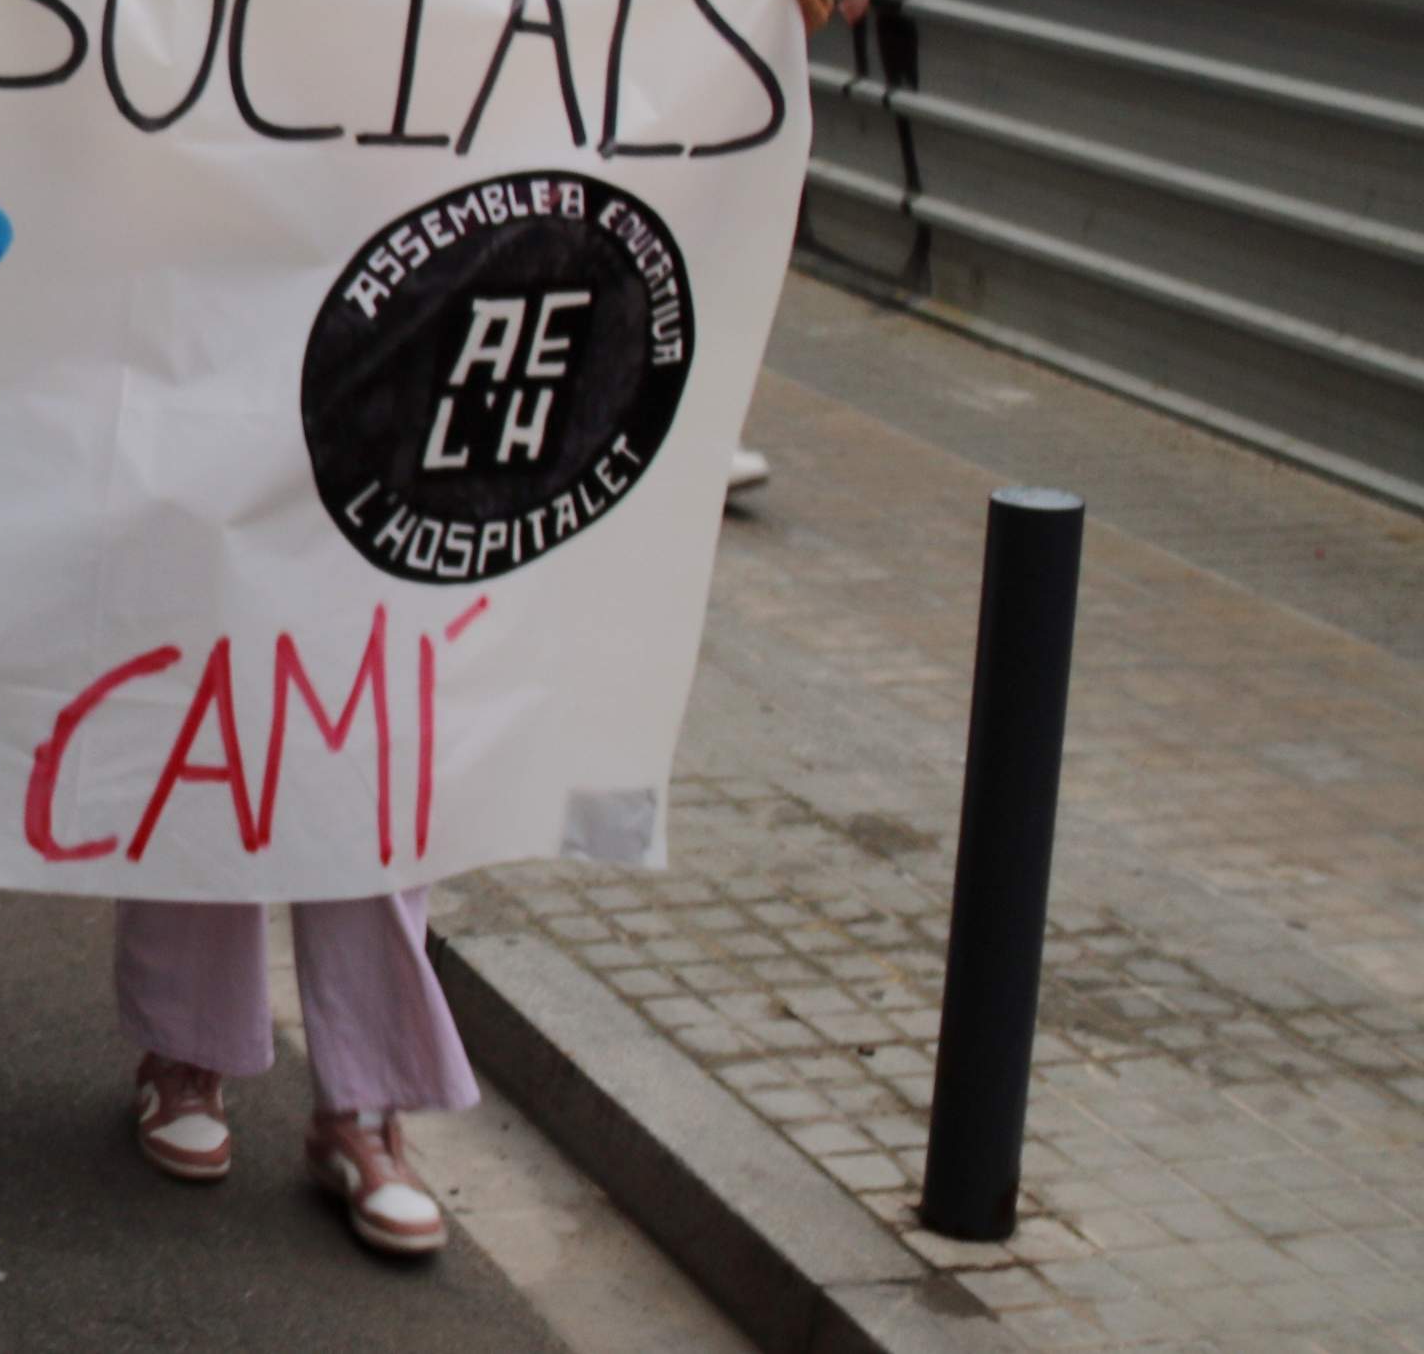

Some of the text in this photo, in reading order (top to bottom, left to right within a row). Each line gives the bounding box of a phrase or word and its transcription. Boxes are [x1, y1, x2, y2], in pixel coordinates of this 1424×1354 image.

[343, 179, 585, 319] ASSEMBLEA
[449, 291, 591, 385] AE
[422, 389, 554, 470] L'H
[343, 433, 642, 578] L'HOSPITALET
[23, 595, 489, 867] CAMÍ
